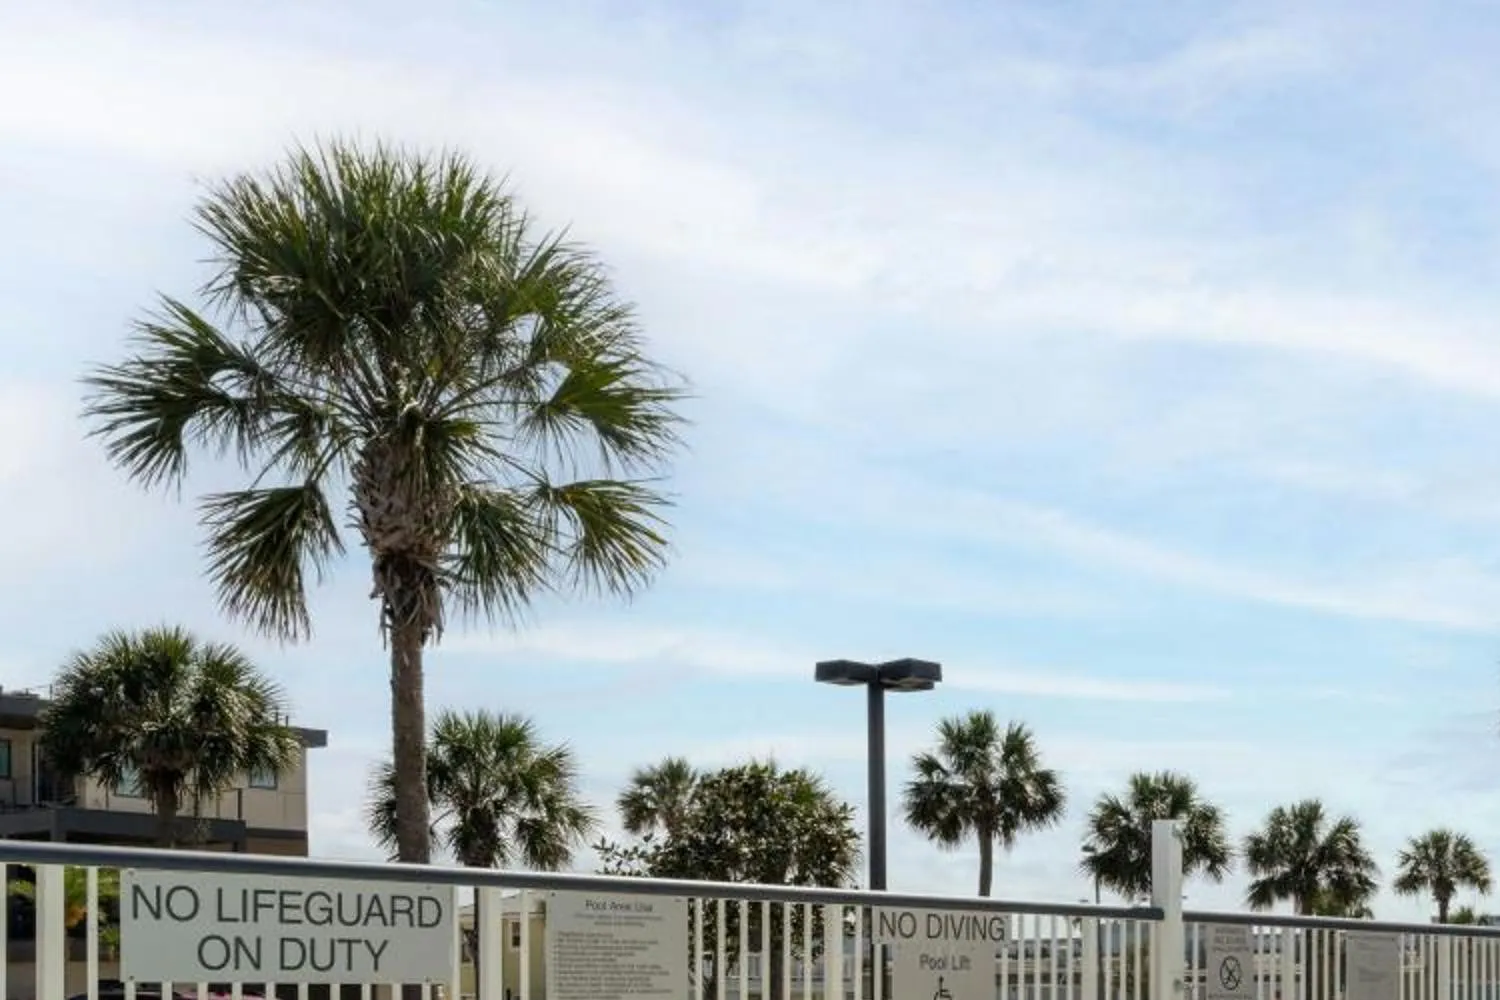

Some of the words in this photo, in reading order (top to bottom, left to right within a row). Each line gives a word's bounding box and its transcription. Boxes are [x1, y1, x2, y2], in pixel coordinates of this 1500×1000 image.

[132, 885, 199, 921] NO
[217, 887, 442, 928] LIFEGUARD
[879, 911, 917, 938] NO
[926, 913, 1005, 941] DIVING
[197, 935, 262, 971] ON
[279, 937, 388, 971] DUTY
[919, 954, 947, 970] Pool
